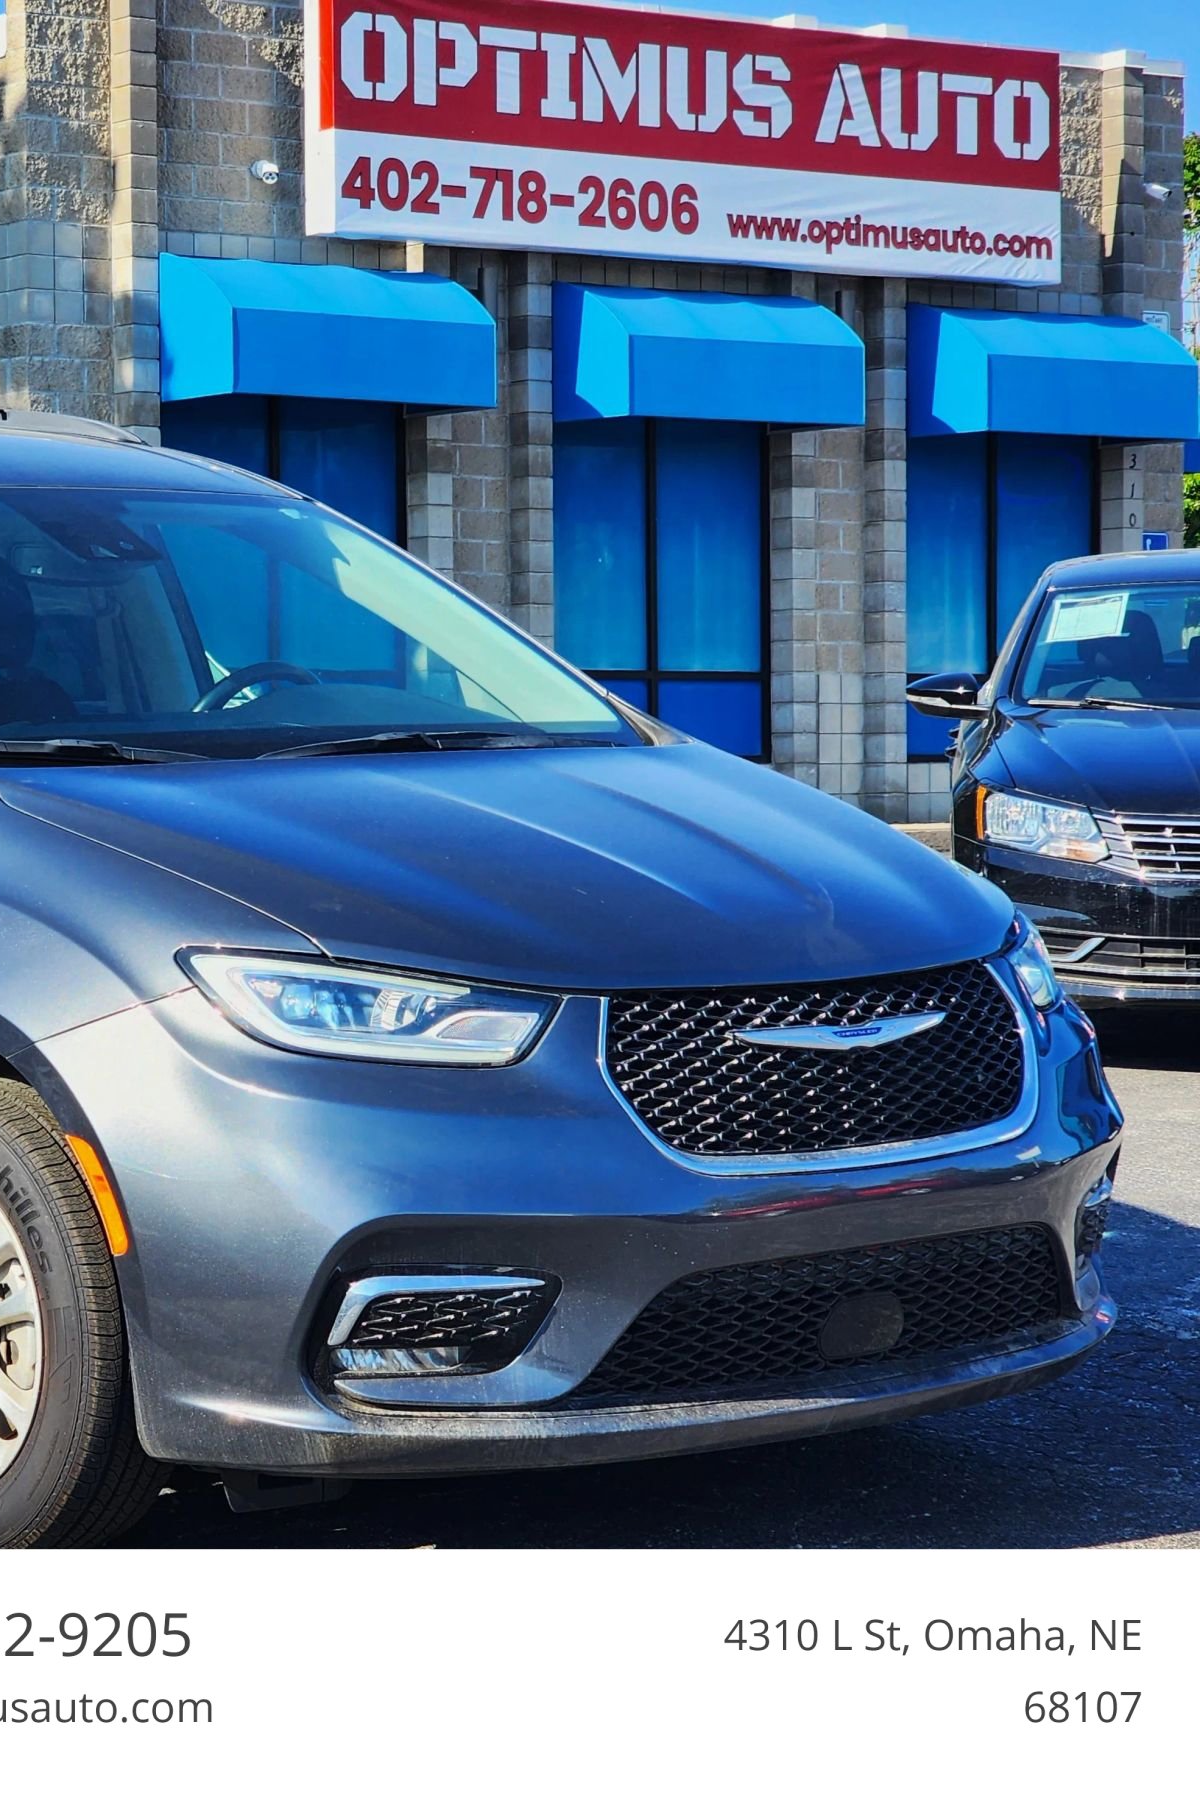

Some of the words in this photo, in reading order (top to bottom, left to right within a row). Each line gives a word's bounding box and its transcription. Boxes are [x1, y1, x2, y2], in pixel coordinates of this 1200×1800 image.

[339, 11, 792, 140] OPTIMUS
[815, 62, 1051, 162] AUTO
[341, 156, 699, 235] 402-718-2606
[726, 212, 1053, 261] www.optimusauto.com
